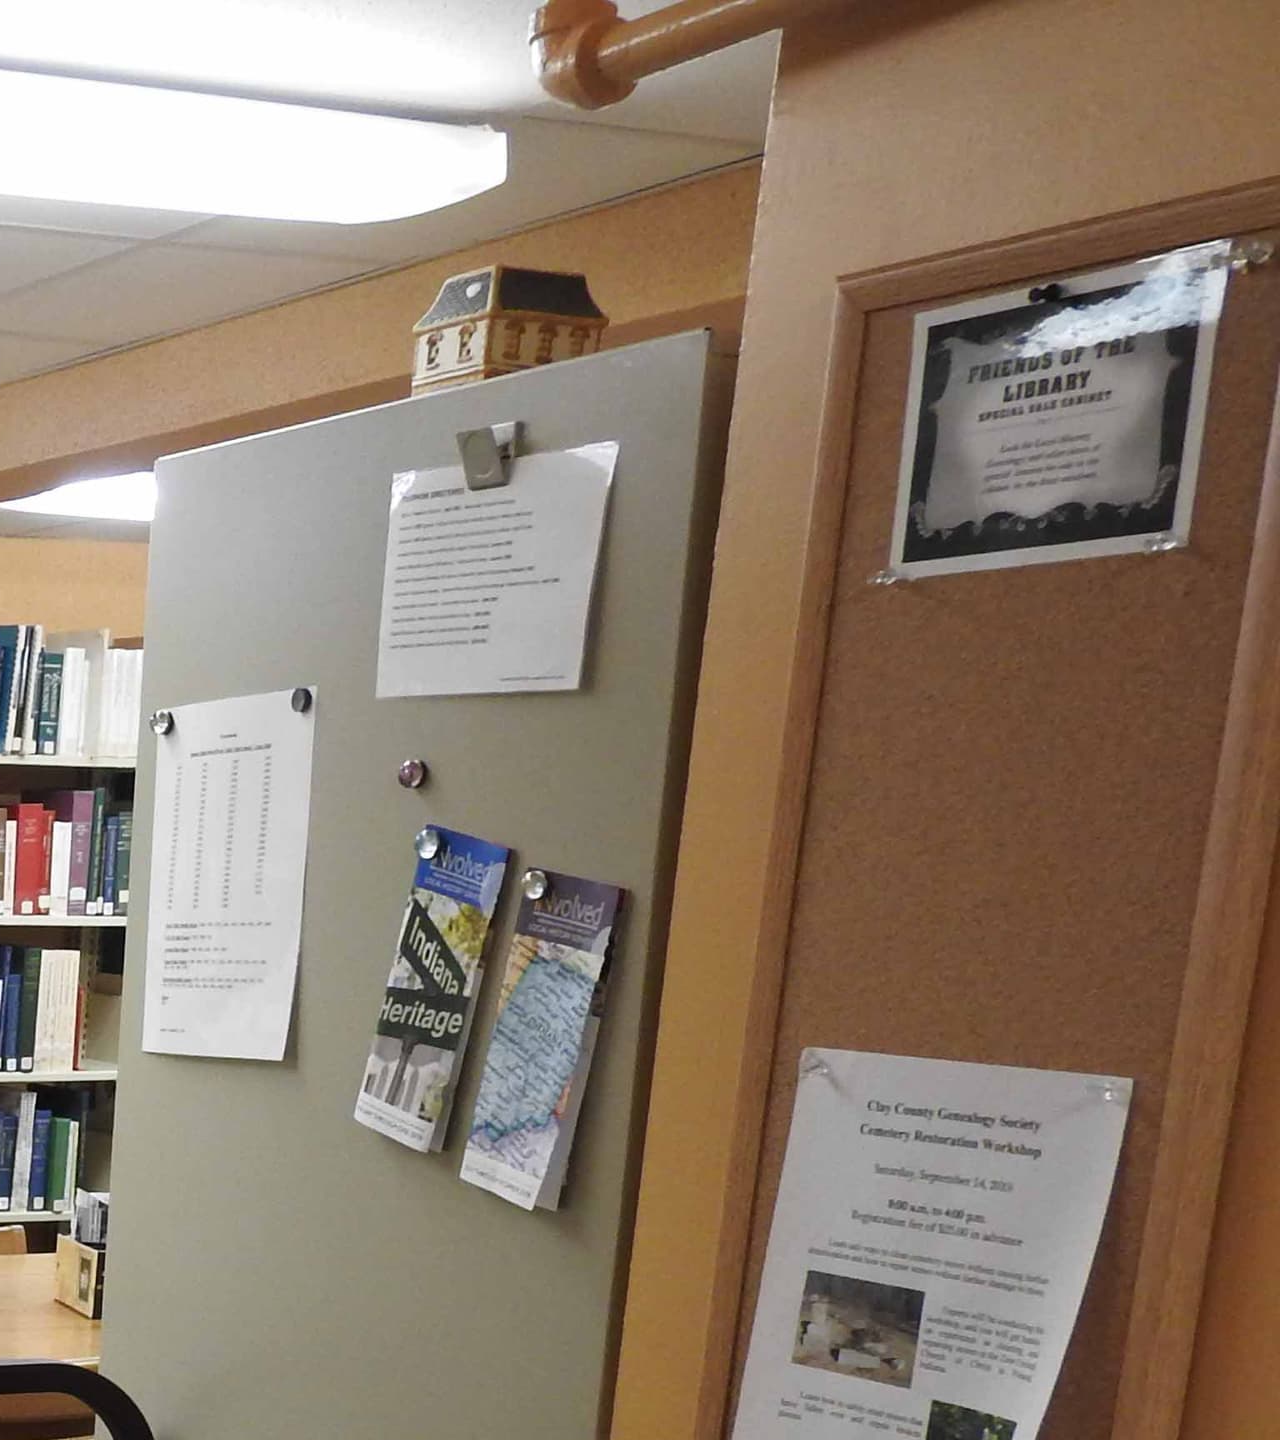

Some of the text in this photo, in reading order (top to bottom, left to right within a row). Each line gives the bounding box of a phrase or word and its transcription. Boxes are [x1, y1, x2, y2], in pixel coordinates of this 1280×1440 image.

[967, 351, 1053, 384] FRIENDS
[1060, 346, 1086, 365] OF
[1002, 370, 1091, 403] LIBRARY
[408, 915, 459, 995] Indiana
[379, 996, 463, 1038] Heritage
[867, 1100, 1042, 1133] Clay County Genealogy Society
[860, 1123, 1042, 1160] Cemetery Restoration Workshop
